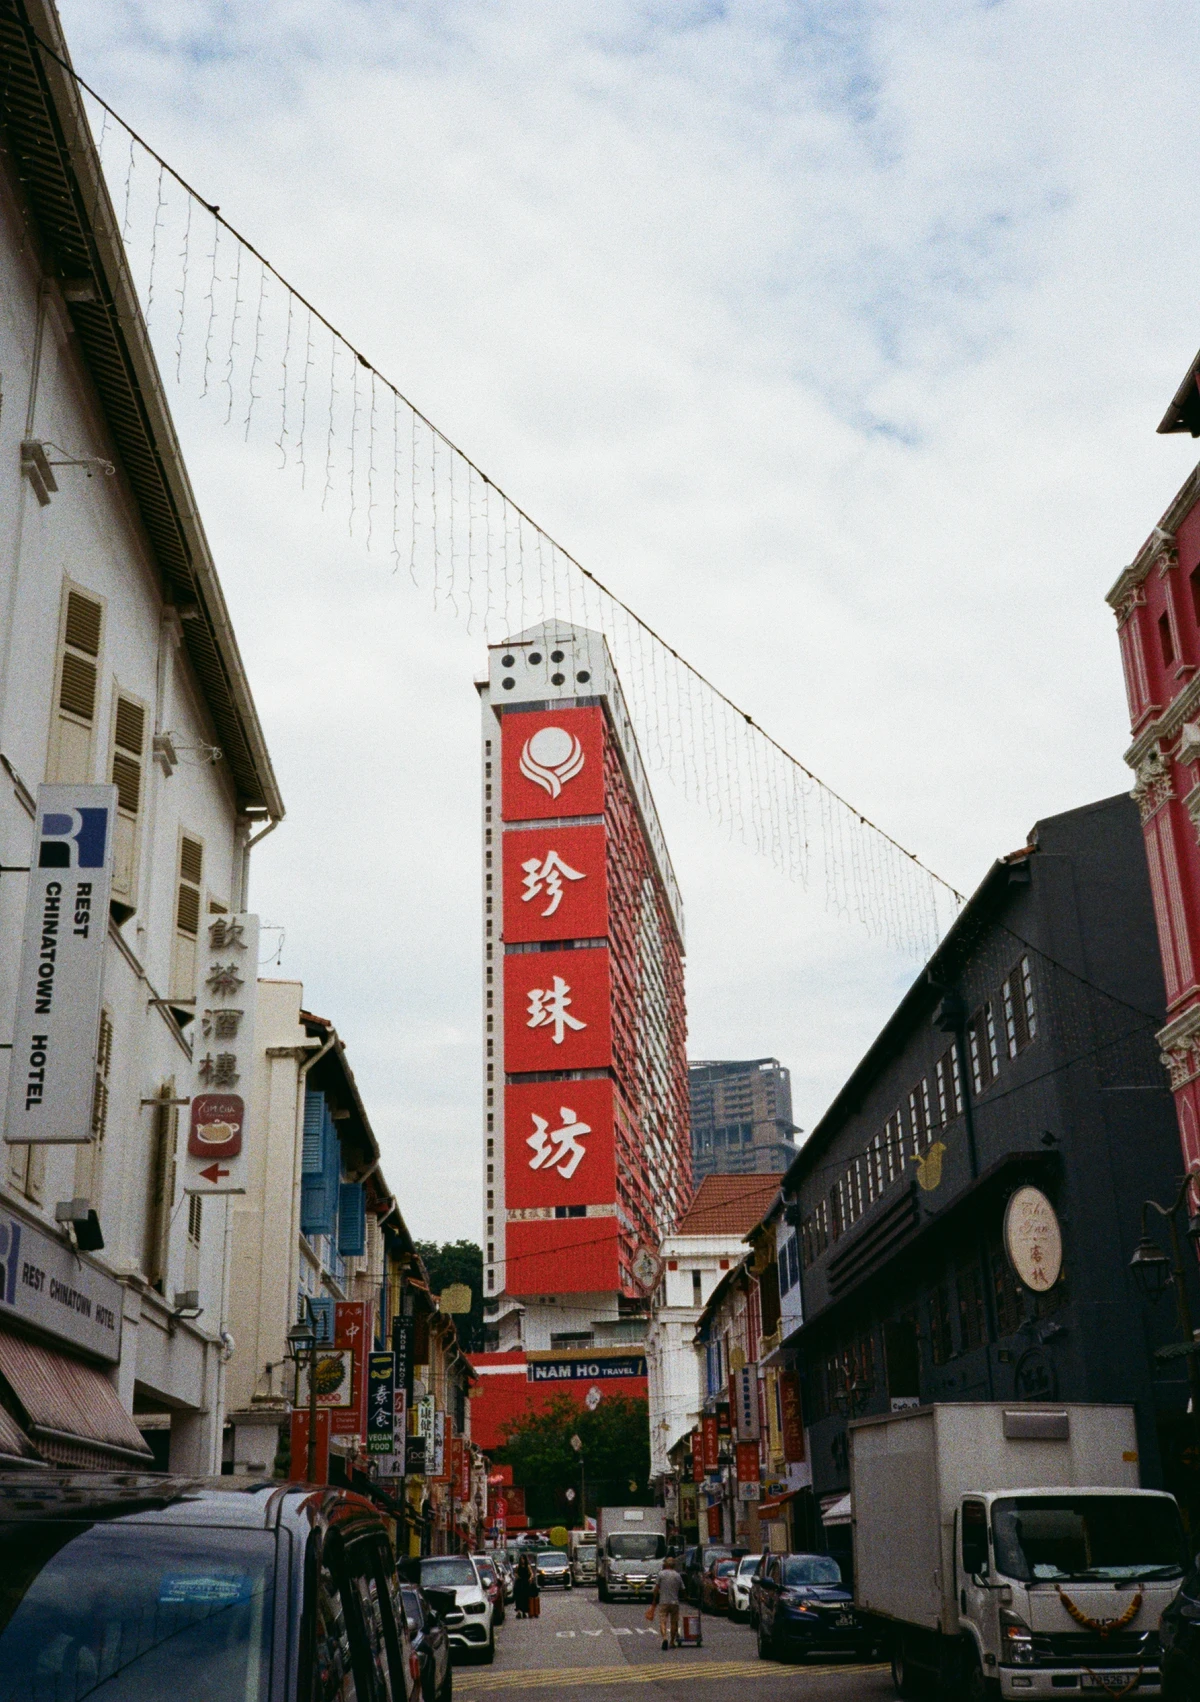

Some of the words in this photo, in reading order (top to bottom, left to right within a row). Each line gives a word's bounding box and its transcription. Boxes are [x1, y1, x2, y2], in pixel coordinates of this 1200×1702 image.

[73, 882, 92, 939] REST
[35, 882, 62, 1014] CHINATOWN
[25, 1035, 48, 1111] HOTEL
[22, 1262, 46, 1292] REST
[50, 1278, 92, 1318] CHINATOWN
[95, 1305, 115, 1331] HOTEL
[399, 1328, 407, 1350] KNOB
[535, 1365, 572, 1379] NAM
[576, 1364, 600, 1377] HO
[602, 1367, 634, 1375] TRAVEL
[368, 1433, 392, 1442] VEGAN
[370, 1442, 390, 1451] FOOD
